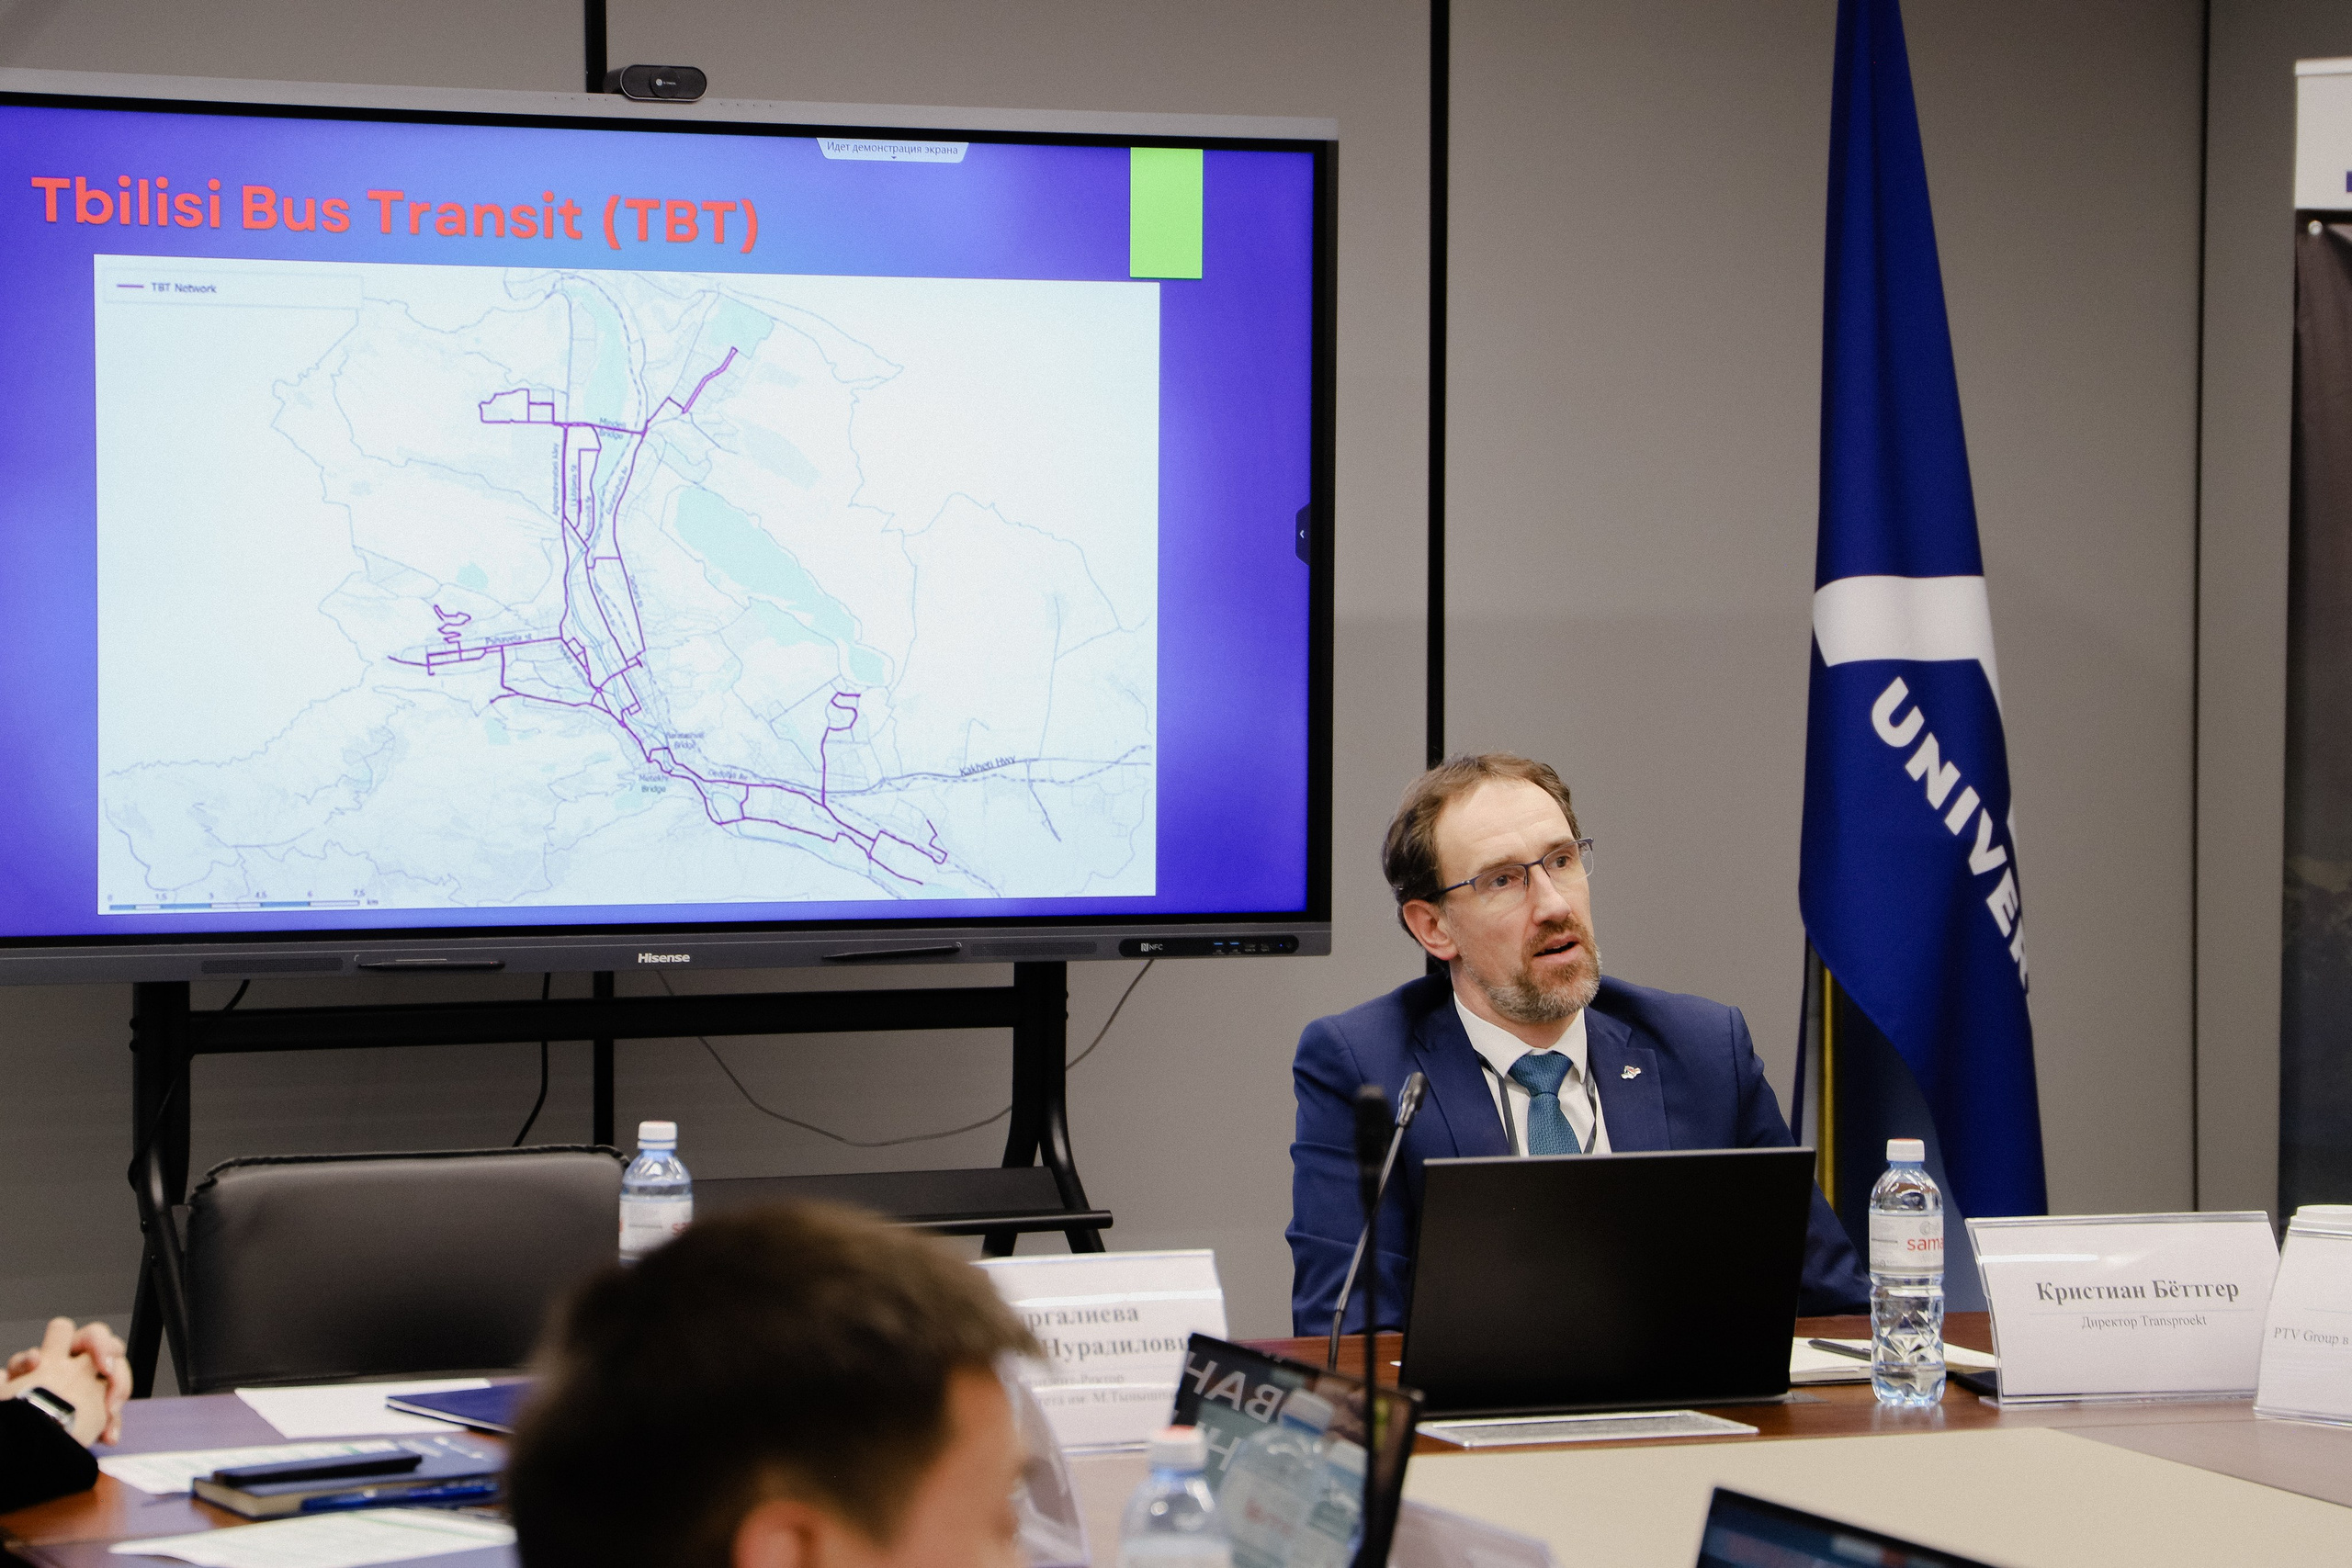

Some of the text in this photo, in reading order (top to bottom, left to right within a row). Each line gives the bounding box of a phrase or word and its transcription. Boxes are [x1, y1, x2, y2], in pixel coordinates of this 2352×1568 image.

[826, 141, 958, 155] Идет демонстрация экрана
[31, 175, 759, 254] Tbilisi Bus Transit (TBT)
[152, 282, 217, 294] TBT Network
[641, 785, 667, 795] Bridge
[1149, 943, 1164, 952] NFC
[638, 953, 691, 964] Hisense
[2035, 1280, 2240, 1305] Кристиан Бёттгер
[1024, 1307, 1139, 1331] ргалиева
[2081, 1314, 2208, 1330] Директор Transproekt
[2274, 1326, 2301, 1340] PTV
[2303, 1329, 2339, 1348] Group
